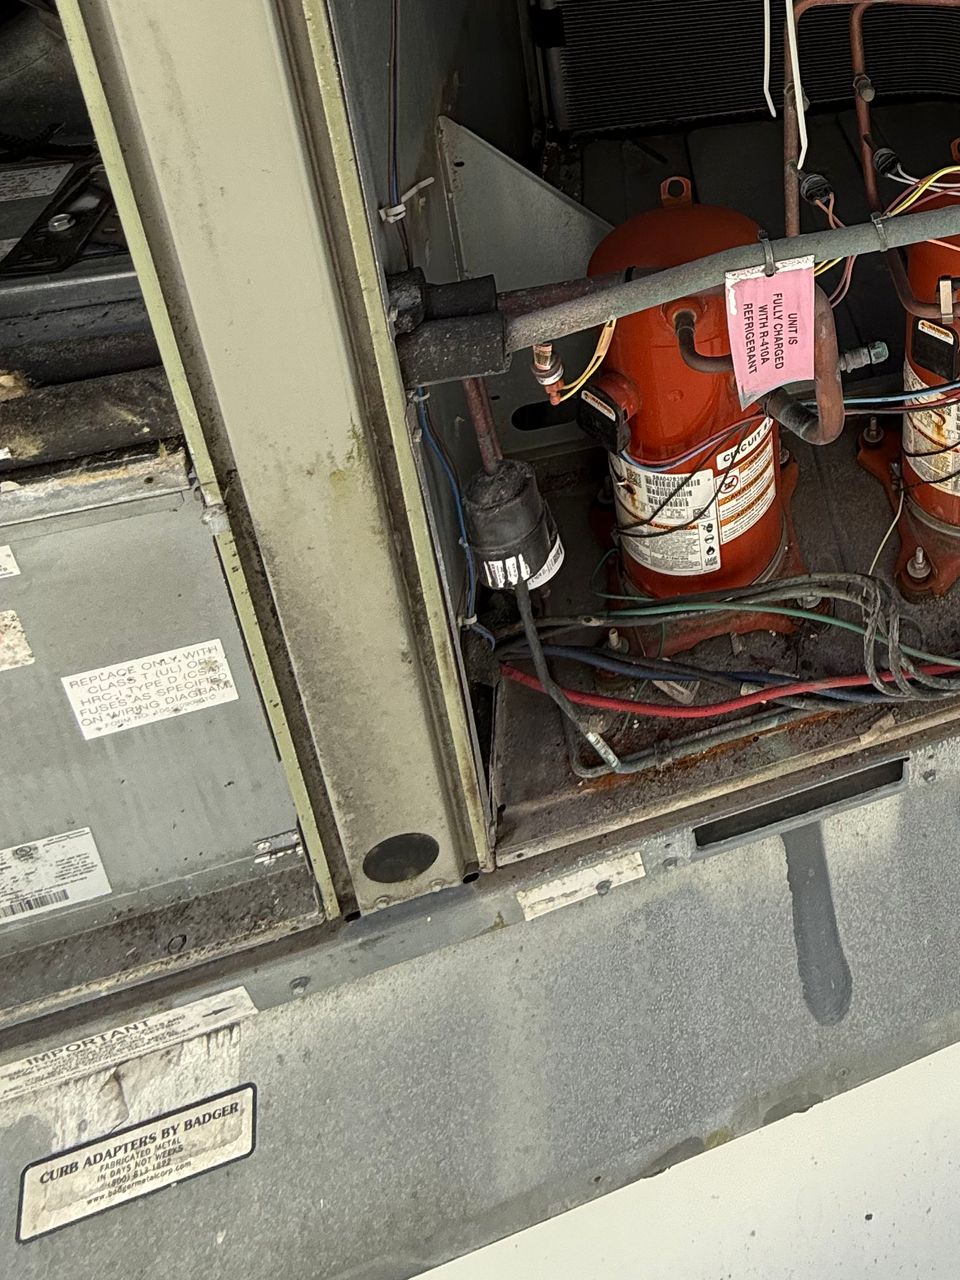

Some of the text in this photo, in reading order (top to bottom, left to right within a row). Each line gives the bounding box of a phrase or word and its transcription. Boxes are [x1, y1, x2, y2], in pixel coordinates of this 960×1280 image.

[743, 303, 758, 374] REFRIGERANT
[758, 304, 770, 365] WITH R-410A
[773, 293, 784, 370] FULLY CHARGED
[788, 313, 798, 345] UNIT IS
[69, 665, 137, 689] REPLACE
[182, 645, 218, 660] WITH
[87, 677, 137, 695] CLASS
[155, 665, 182, 679] (UL)
[127, 680, 163, 695] TYPE
[168, 676, 178, 684] D
[79, 673, 228, 718] FUSES AS SPECIFIED
[81, 716, 103, 727] ON
[26, 1019, 151, 1067] IMPORTANT
[39, 1101, 240, 1184] CURB ADAPTERS BY BADGER
[96, 1144, 184, 1183] IN DAYS NOT WEEKS
[99, 1136, 182, 1171] FABRICATED METAL
